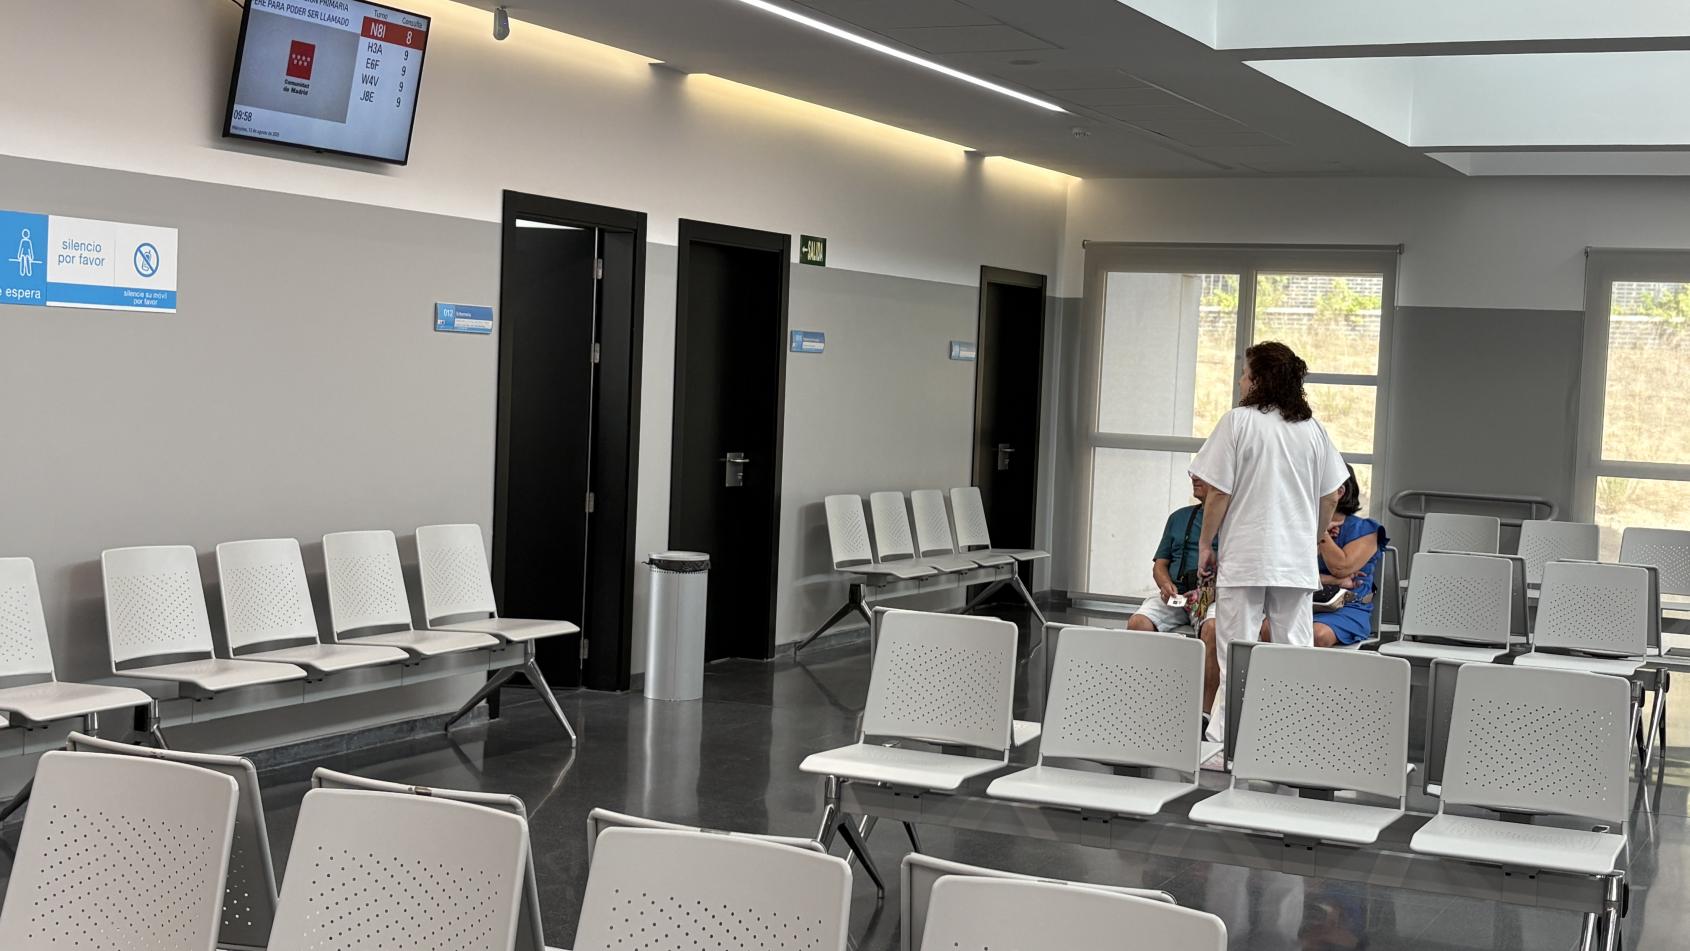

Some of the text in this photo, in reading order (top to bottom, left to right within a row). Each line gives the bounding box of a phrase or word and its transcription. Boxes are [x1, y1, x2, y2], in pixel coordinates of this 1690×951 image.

[267, 0, 285, 12] PARA
[286, 4, 307, 16] PODER
[307, 9, 319, 19] SER
[320, 13, 350, 27] LLAMADO
[374, 9, 423, 29] Turno Consulta
[406, 31, 413, 44] 8
[367, 41, 409, 60] H3A 9
[365, 58, 407, 76] E6F 9
[285, 79, 310, 89] Comunidad
[361, 73, 404, 92] W4V 9
[290, 87, 309, 96] Madrid
[360, 90, 401, 108] J8E 9
[233, 109, 252, 122] 09:58
[62, 239, 102, 253] silencio
[808, 240, 823, 262] SALIDA
[58, 253, 105, 267] por favor
[6, 288, 41, 300] espera
